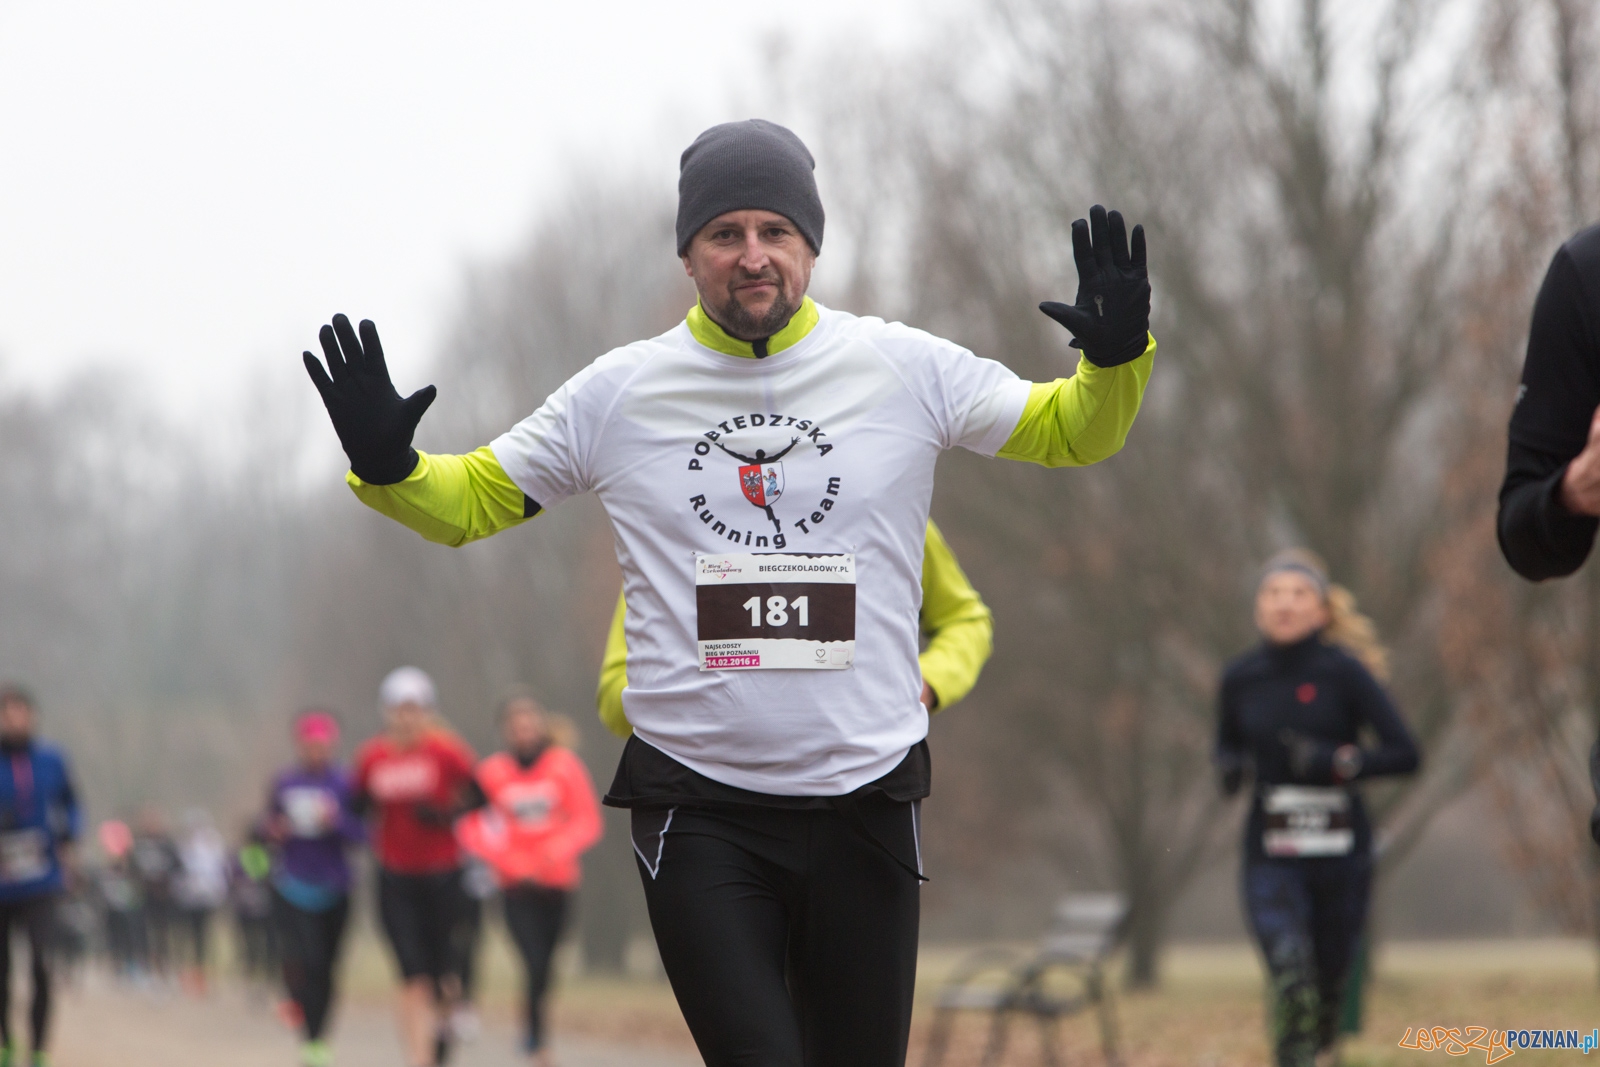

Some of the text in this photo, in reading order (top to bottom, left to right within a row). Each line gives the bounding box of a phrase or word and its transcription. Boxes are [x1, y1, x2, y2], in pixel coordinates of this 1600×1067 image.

[688, 414, 833, 470] POBIEDZISKA
[689, 477, 841, 549] Running Team
[758, 565, 849, 573] BIEGCZEKOLADOWY.PL
[742, 595, 809, 627] 181
[707, 658, 750, 667] 14.02.2016
